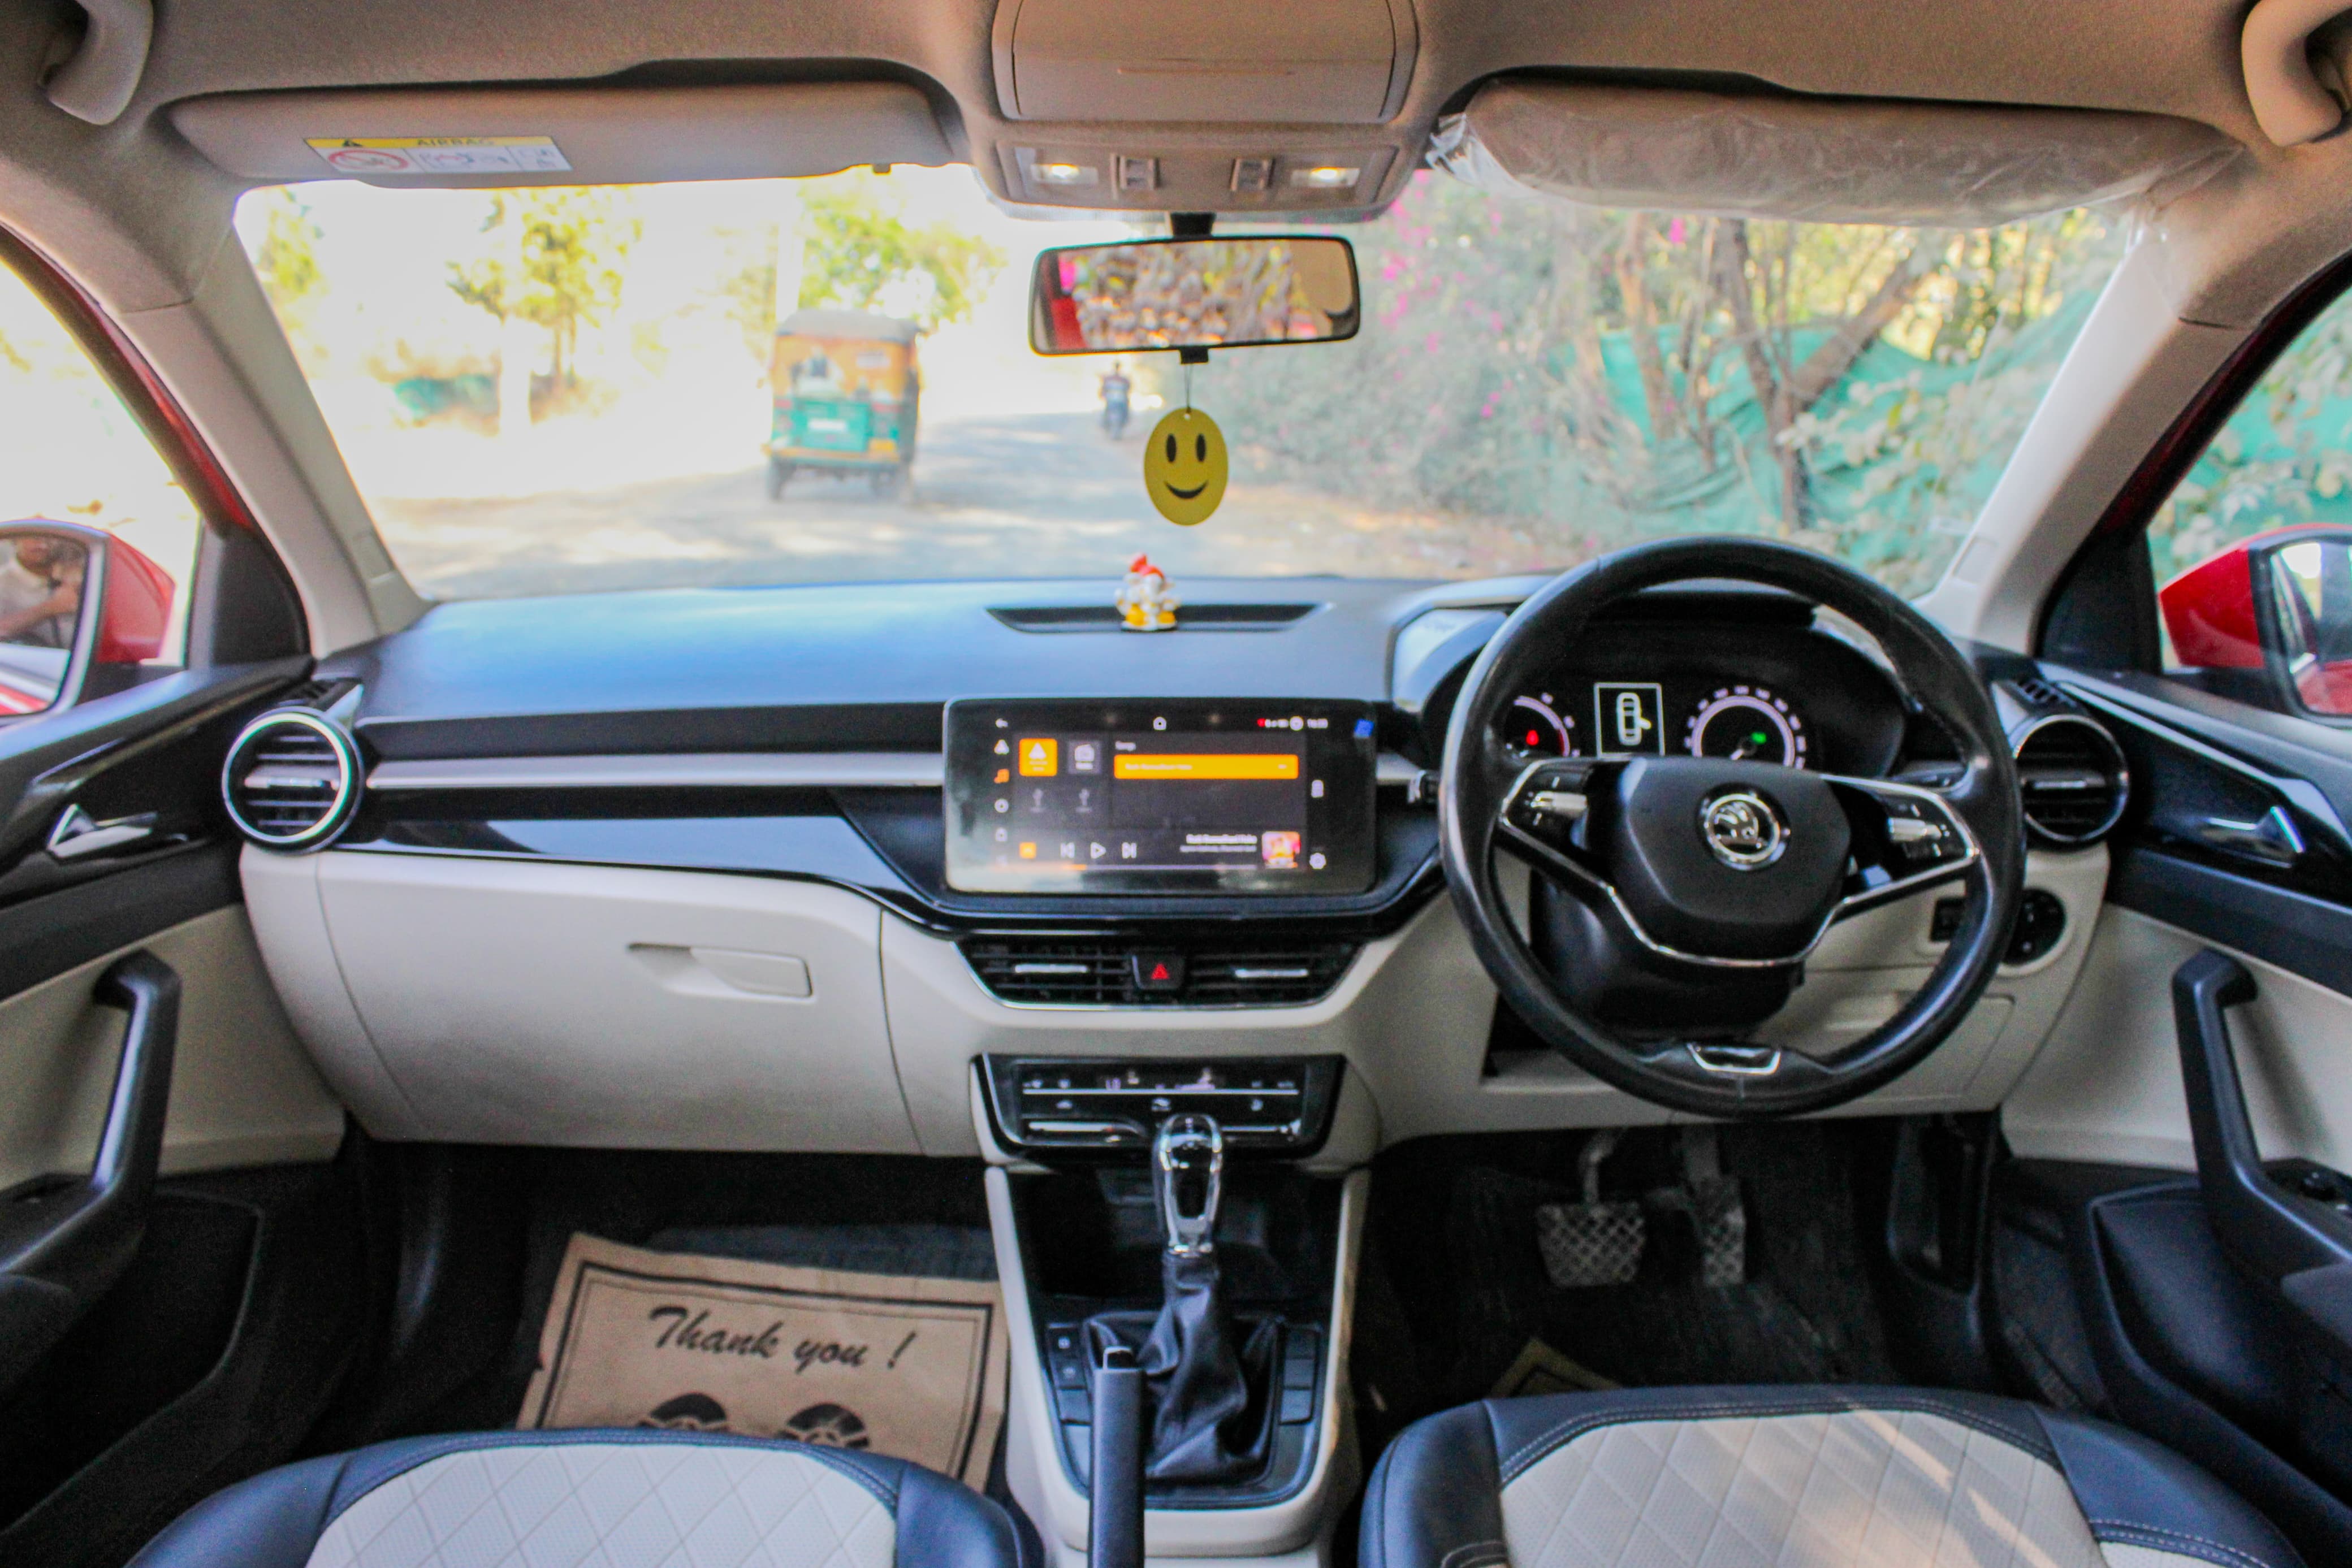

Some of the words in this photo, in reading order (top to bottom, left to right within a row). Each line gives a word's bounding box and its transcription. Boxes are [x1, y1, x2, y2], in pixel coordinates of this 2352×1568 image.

[649, 1305, 785, 1358] Thank
[794, 1339, 868, 1375] you
[887, 1329, 917, 1369] !
